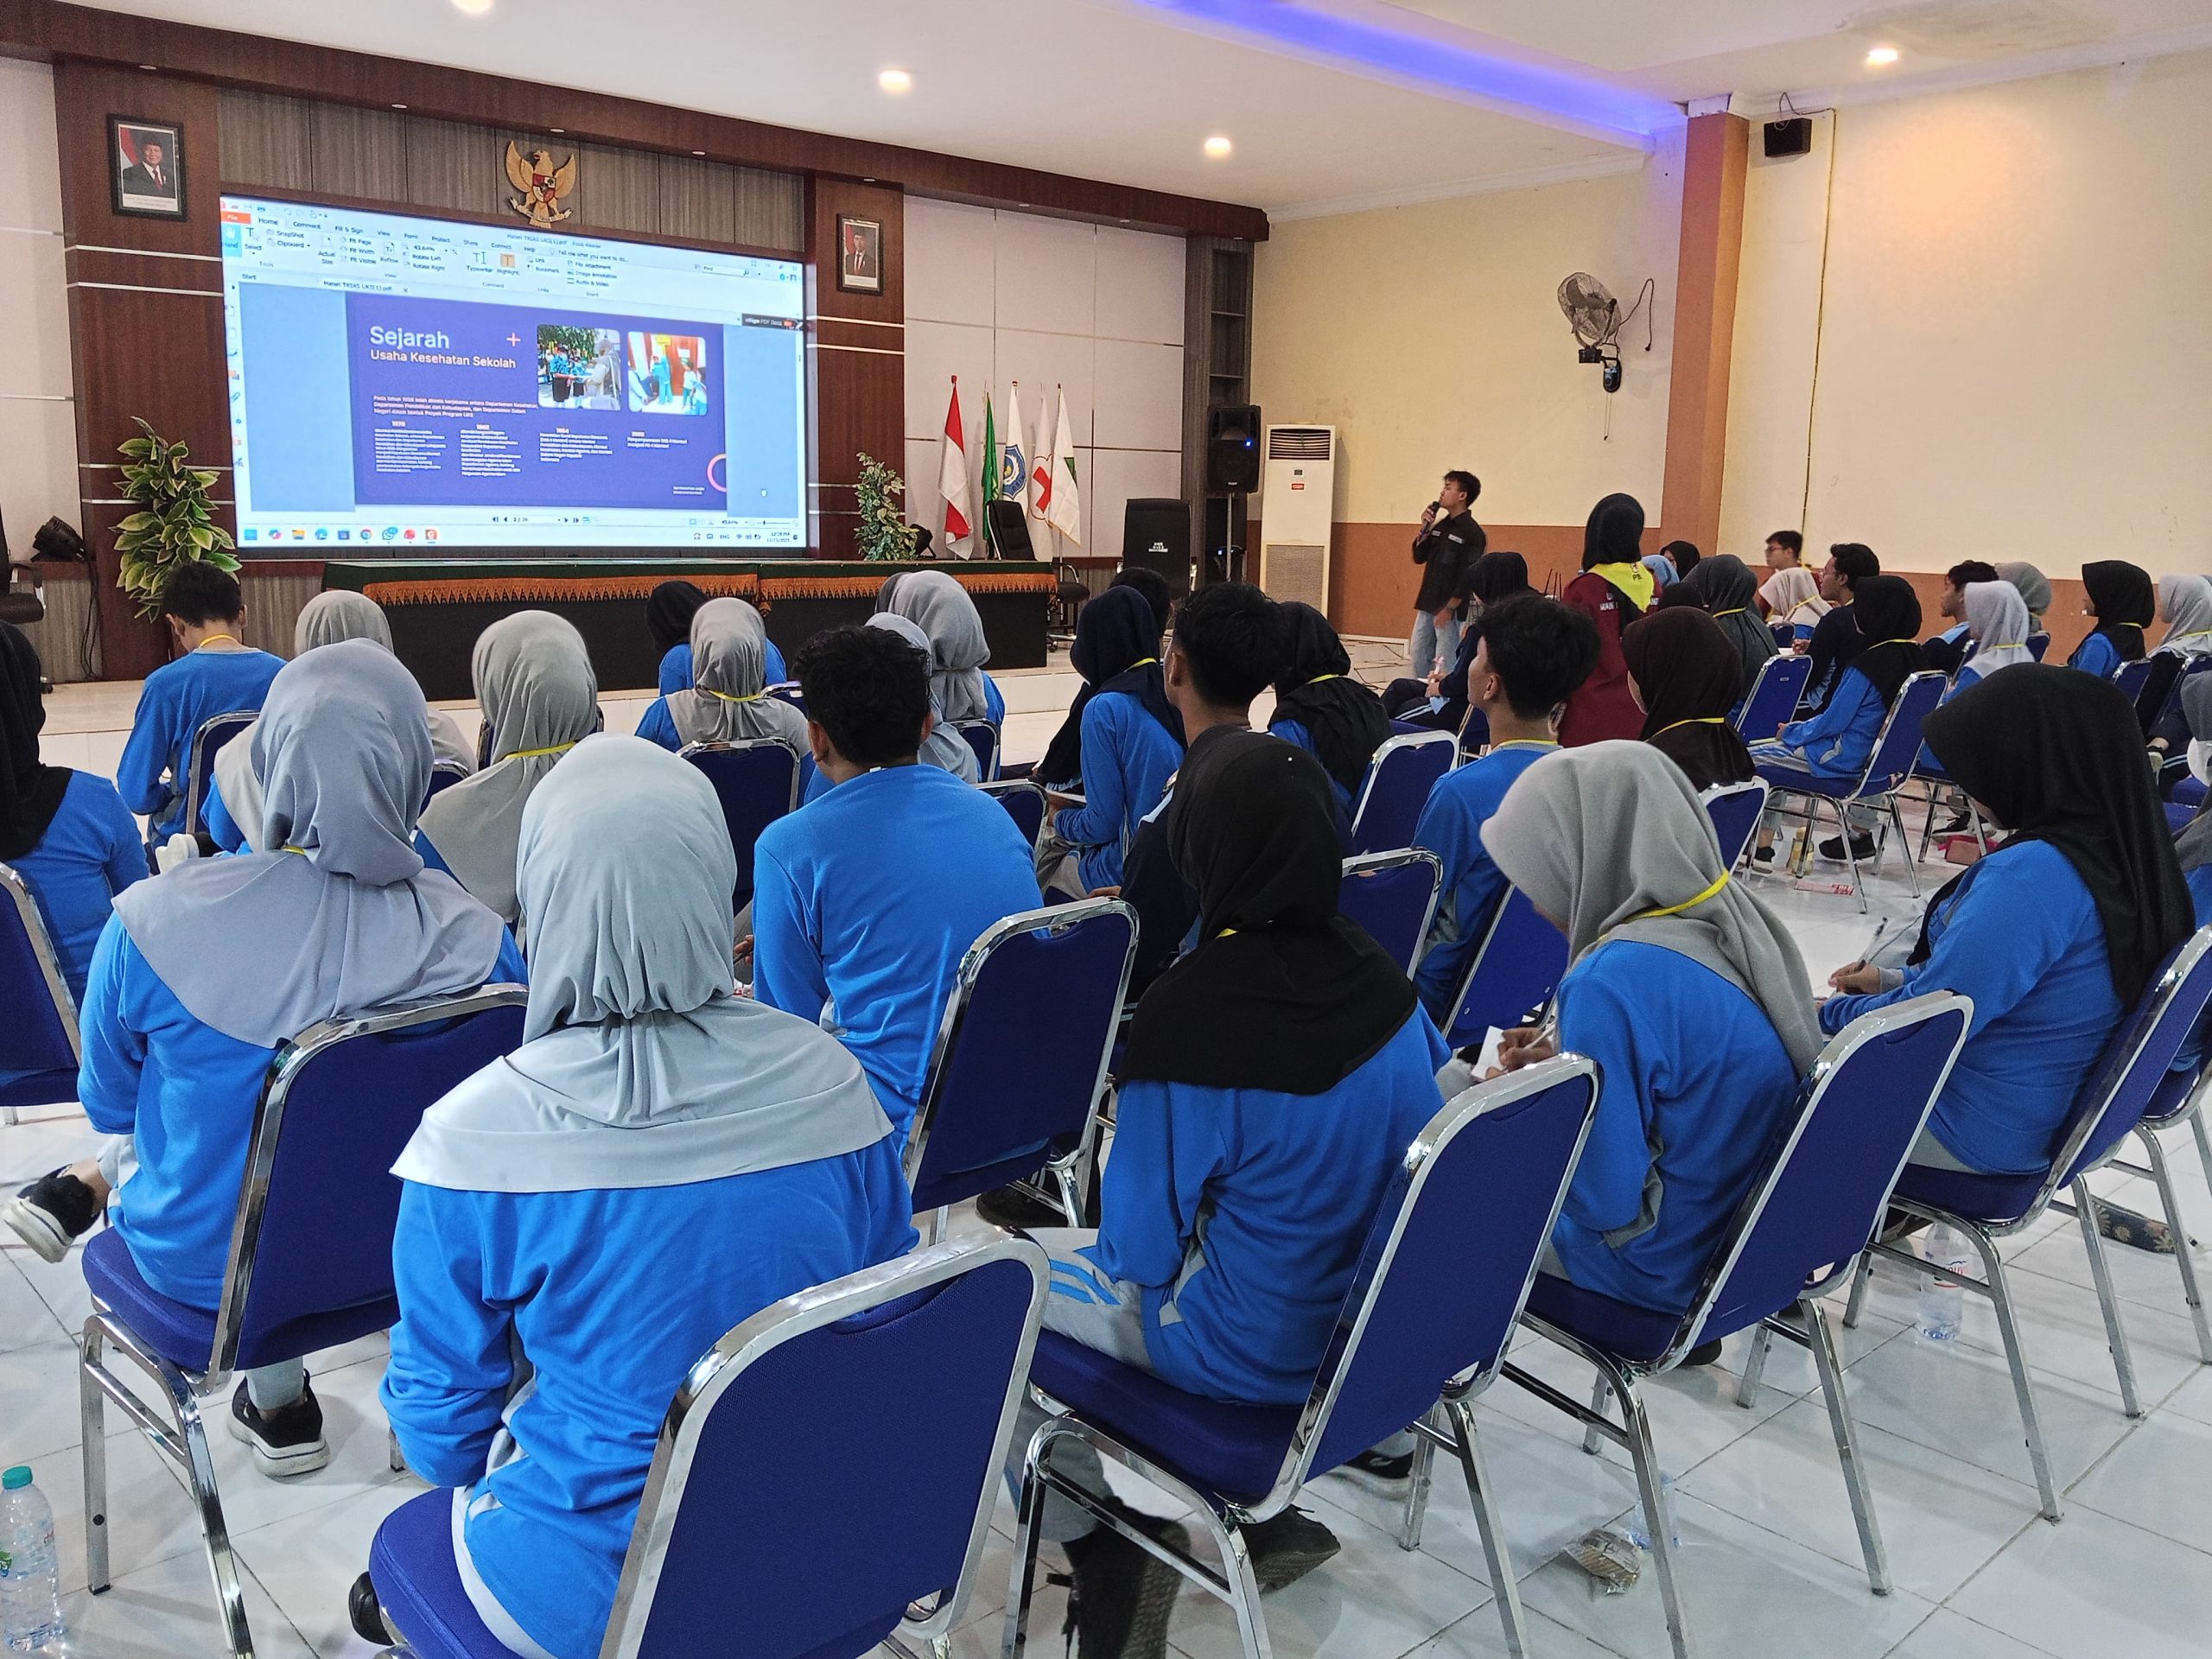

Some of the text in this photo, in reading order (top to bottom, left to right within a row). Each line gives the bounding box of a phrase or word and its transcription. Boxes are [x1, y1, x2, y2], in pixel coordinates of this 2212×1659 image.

[370, 326, 450, 350] Sejarah
[370, 349, 516, 369] Usaha Kesehatan Sekolah
